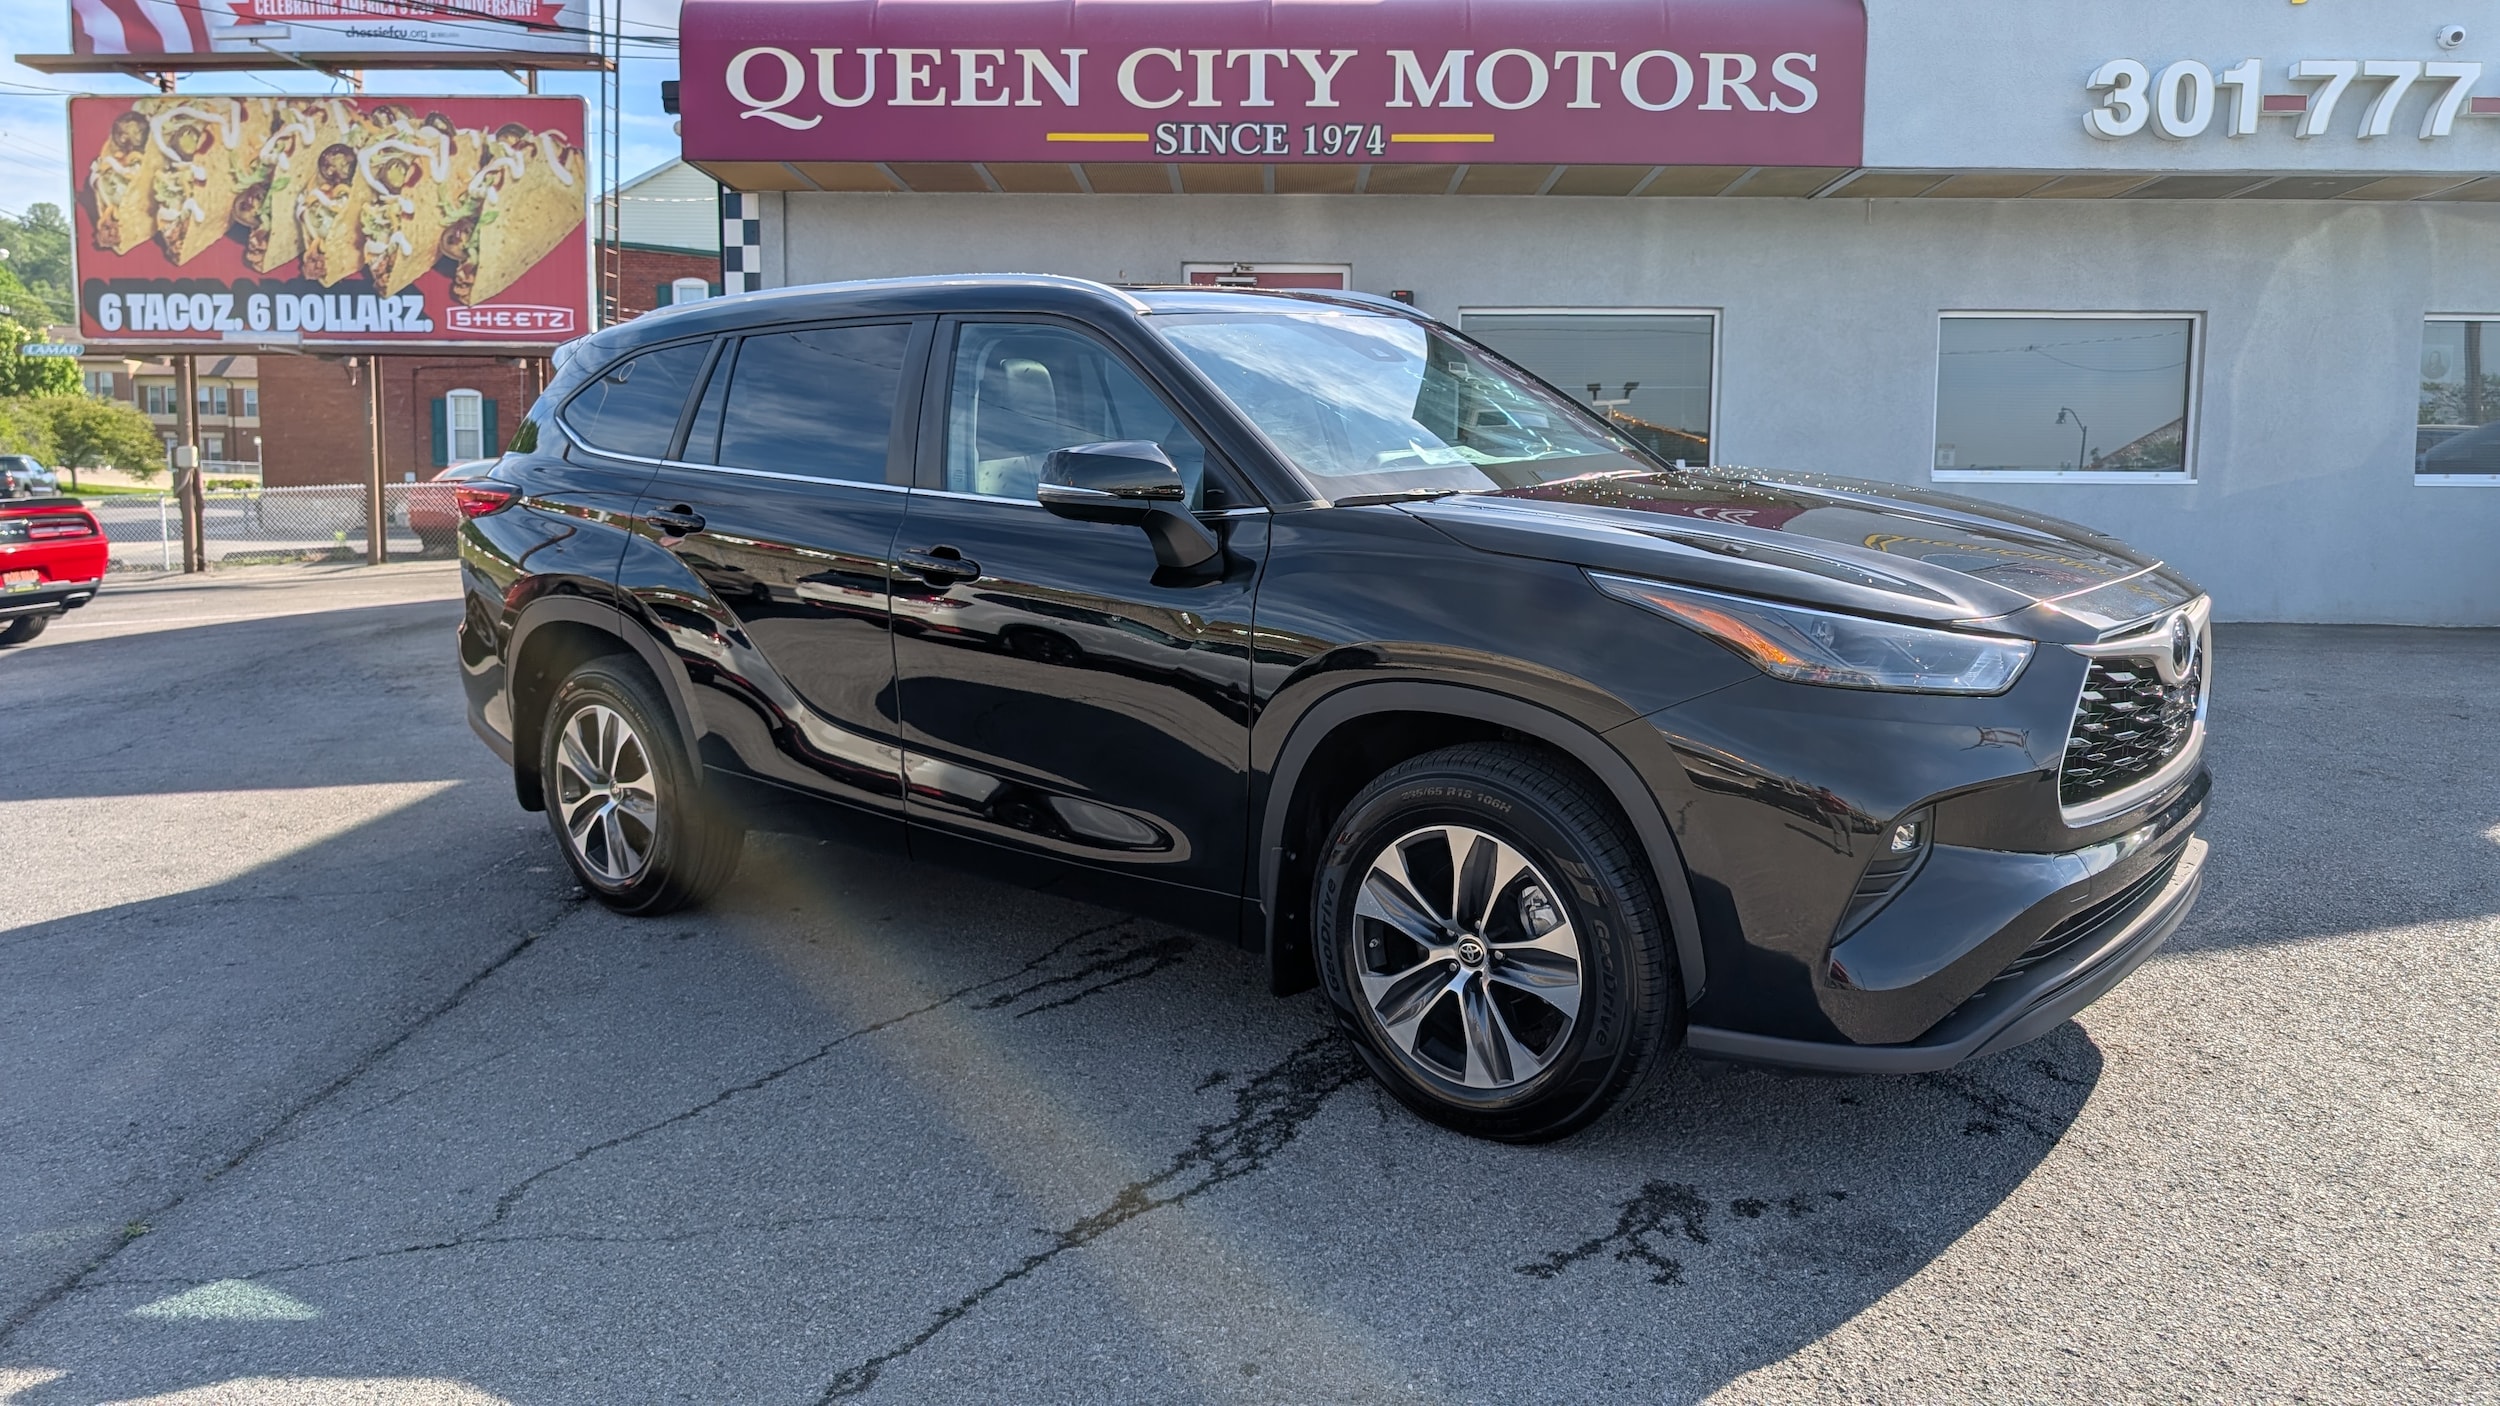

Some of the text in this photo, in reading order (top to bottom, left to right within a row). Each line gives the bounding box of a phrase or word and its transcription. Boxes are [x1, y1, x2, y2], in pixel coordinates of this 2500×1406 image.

[726, 47, 1819, 130] QUEEN CITY MOTORS
[1154, 122, 1387, 156] SINCE 1974
[98, 293, 434, 333] 6 TACOZ. 6 DOLLARZ.
[456, 311, 565, 328] SHEETZ
[26, 344, 79, 355] LAMAR
[1446, 786, 1473, 799] R18
[1477, 793, 1513, 813] 106H
[1320, 877, 1341, 993] GeoDrive
[1593, 918, 1618, 1047] GeoDrive
